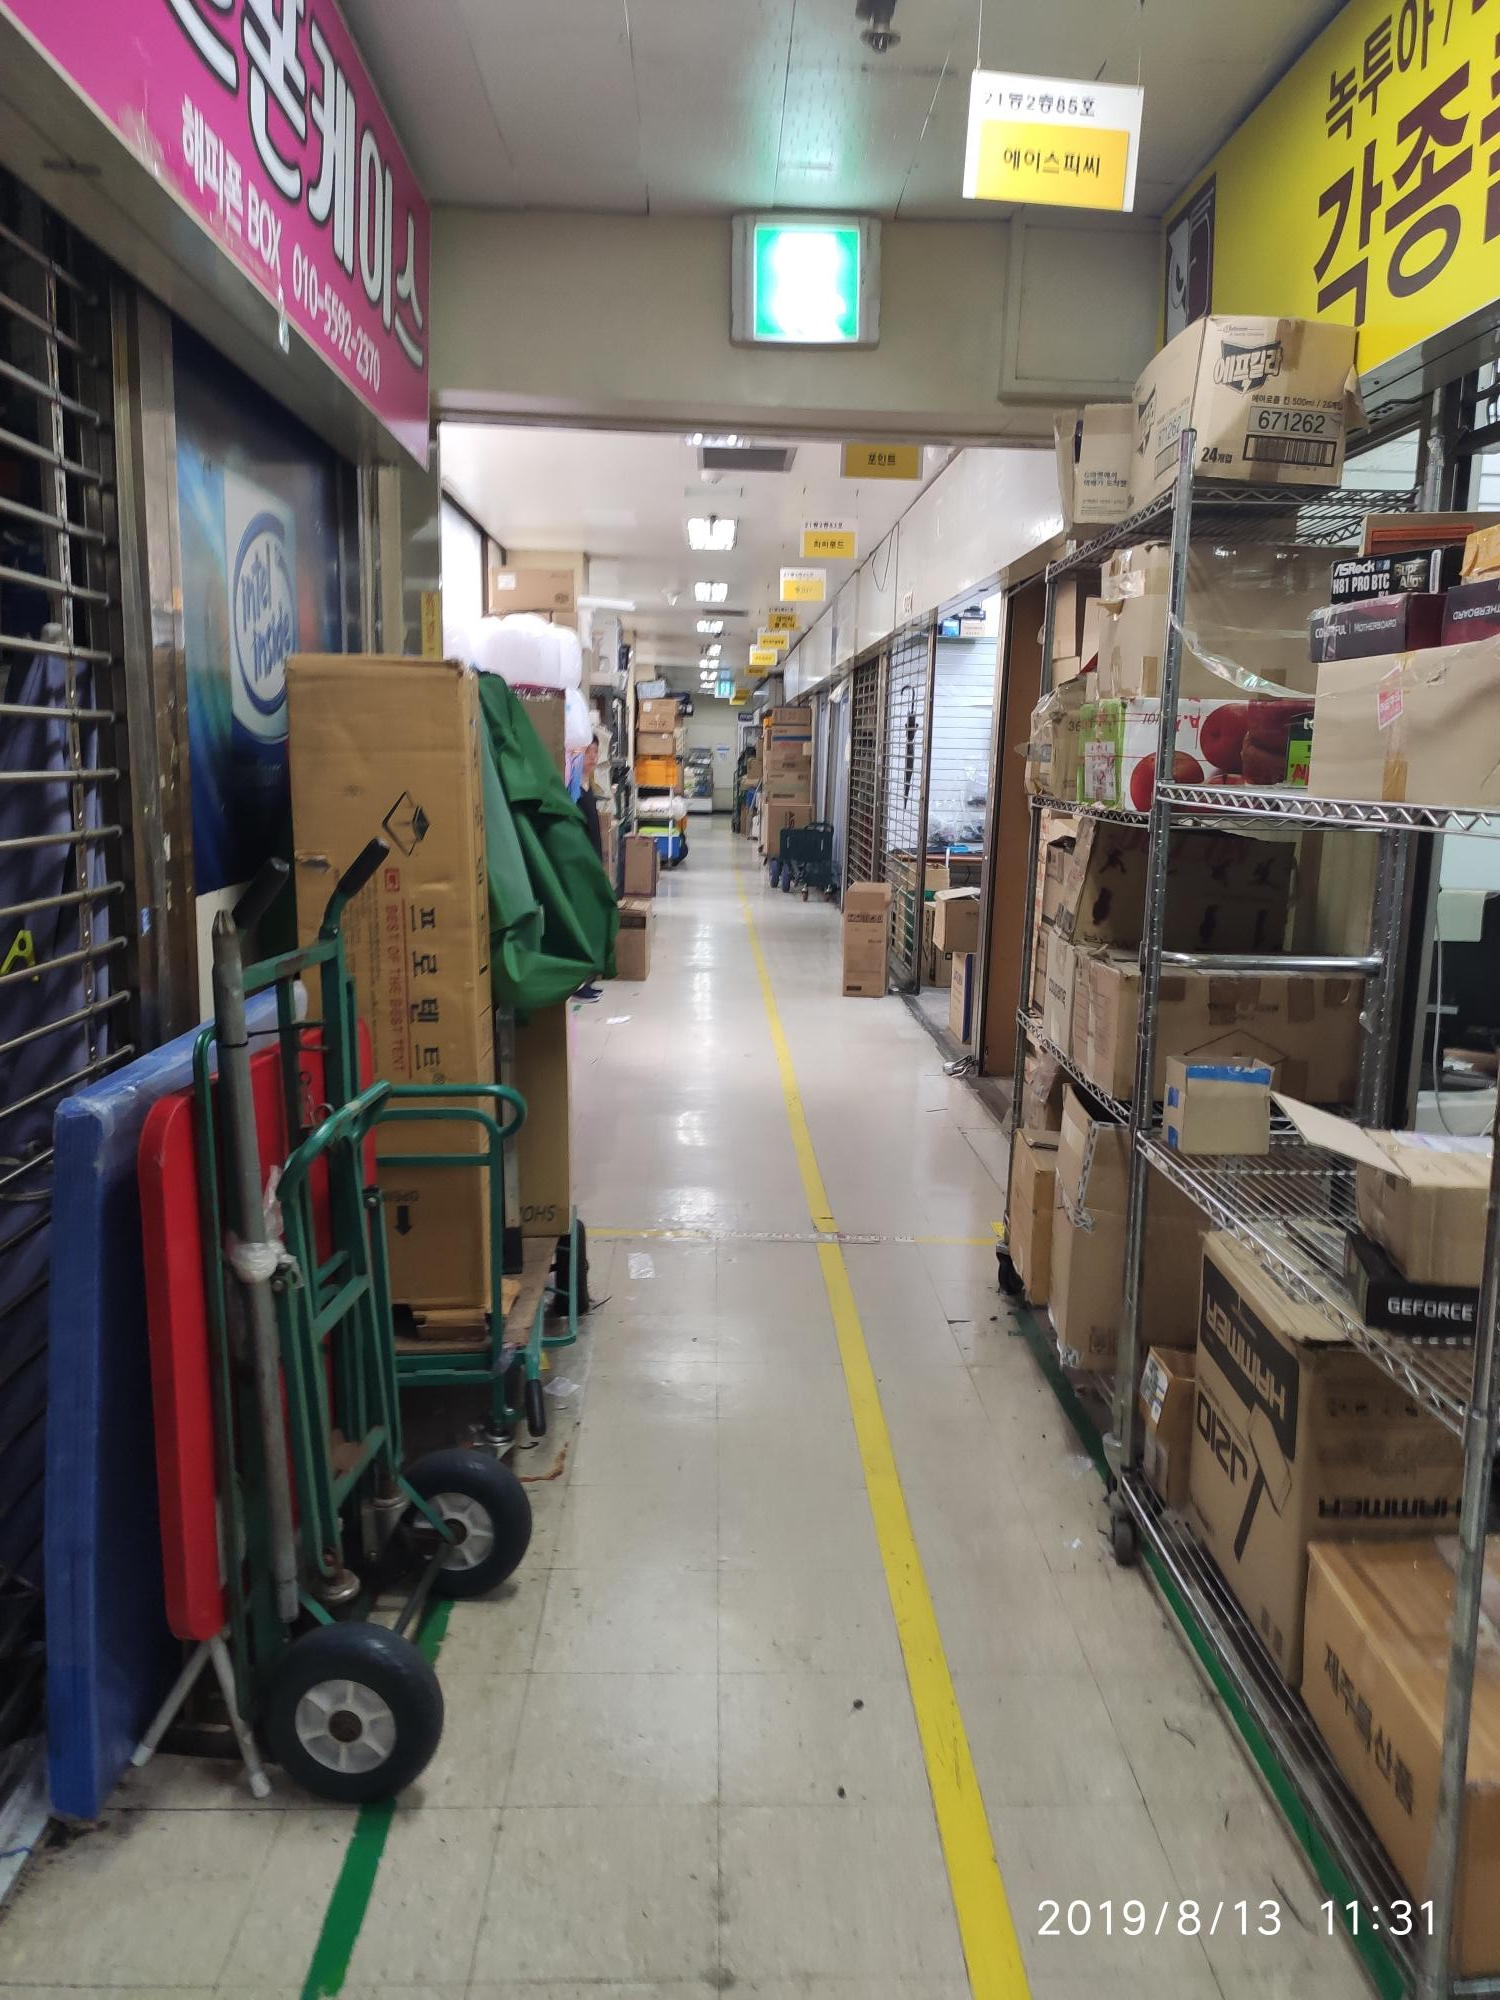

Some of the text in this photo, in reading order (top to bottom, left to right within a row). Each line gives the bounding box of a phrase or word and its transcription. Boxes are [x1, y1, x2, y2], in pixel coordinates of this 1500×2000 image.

[1003, 146, 1101, 178] 에이스피씨
[168, 0, 424, 369] 폰케이스
[1313, 32, 1500, 327] 각종
[181, 93, 381, 394] 해피폰 BOX 010-5592-2370
[1213, 347, 1284, 385] 에프킬라
[1258, 410, 1326, 435] 671262
[1333, 559, 1375, 578] ASRock
[1333, 573, 1390, 595] H81 PRO BTC
[241, 540, 272, 633] intel
[1315, 618, 1397, 639] COFUL MOTHERBOARD
[386, 905, 399, 939] BEST
[387, 946, 399, 960] OF
[388, 967, 400, 994] THE
[410, 905, 441, 1070] 프로텐트
[389, 999, 402, 1033] BEST
[392, 1035, 405, 1072] TENT
[1387, 1296, 1474, 1323] GEFORCE
[1206, 1293, 1286, 1422] HAMMER
